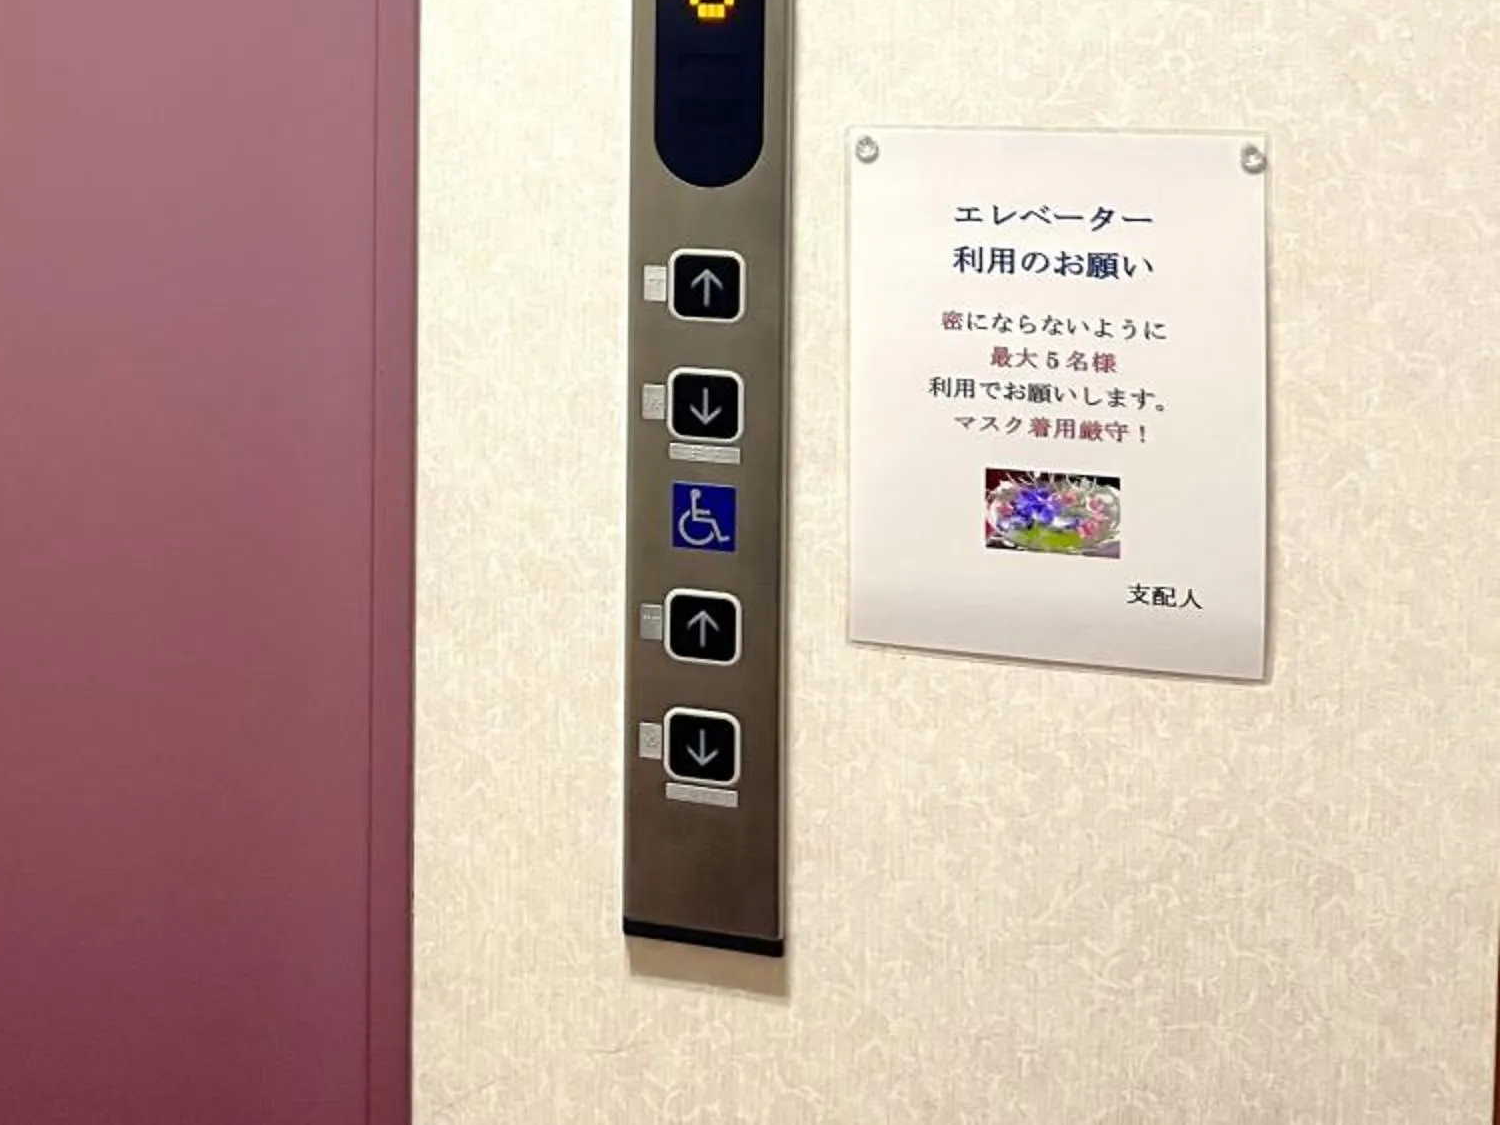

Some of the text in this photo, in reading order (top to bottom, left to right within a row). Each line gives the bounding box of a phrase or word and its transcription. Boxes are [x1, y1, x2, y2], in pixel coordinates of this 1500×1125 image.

[953, 204, 1153, 231] エレベーター
[952, 245, 1154, 279] 利用のお願い
[941, 310, 1167, 340] 密にならないように
[928, 376, 1166, 412] 利用でお願いします。
[1126, 582, 1203, 609] 支配人
